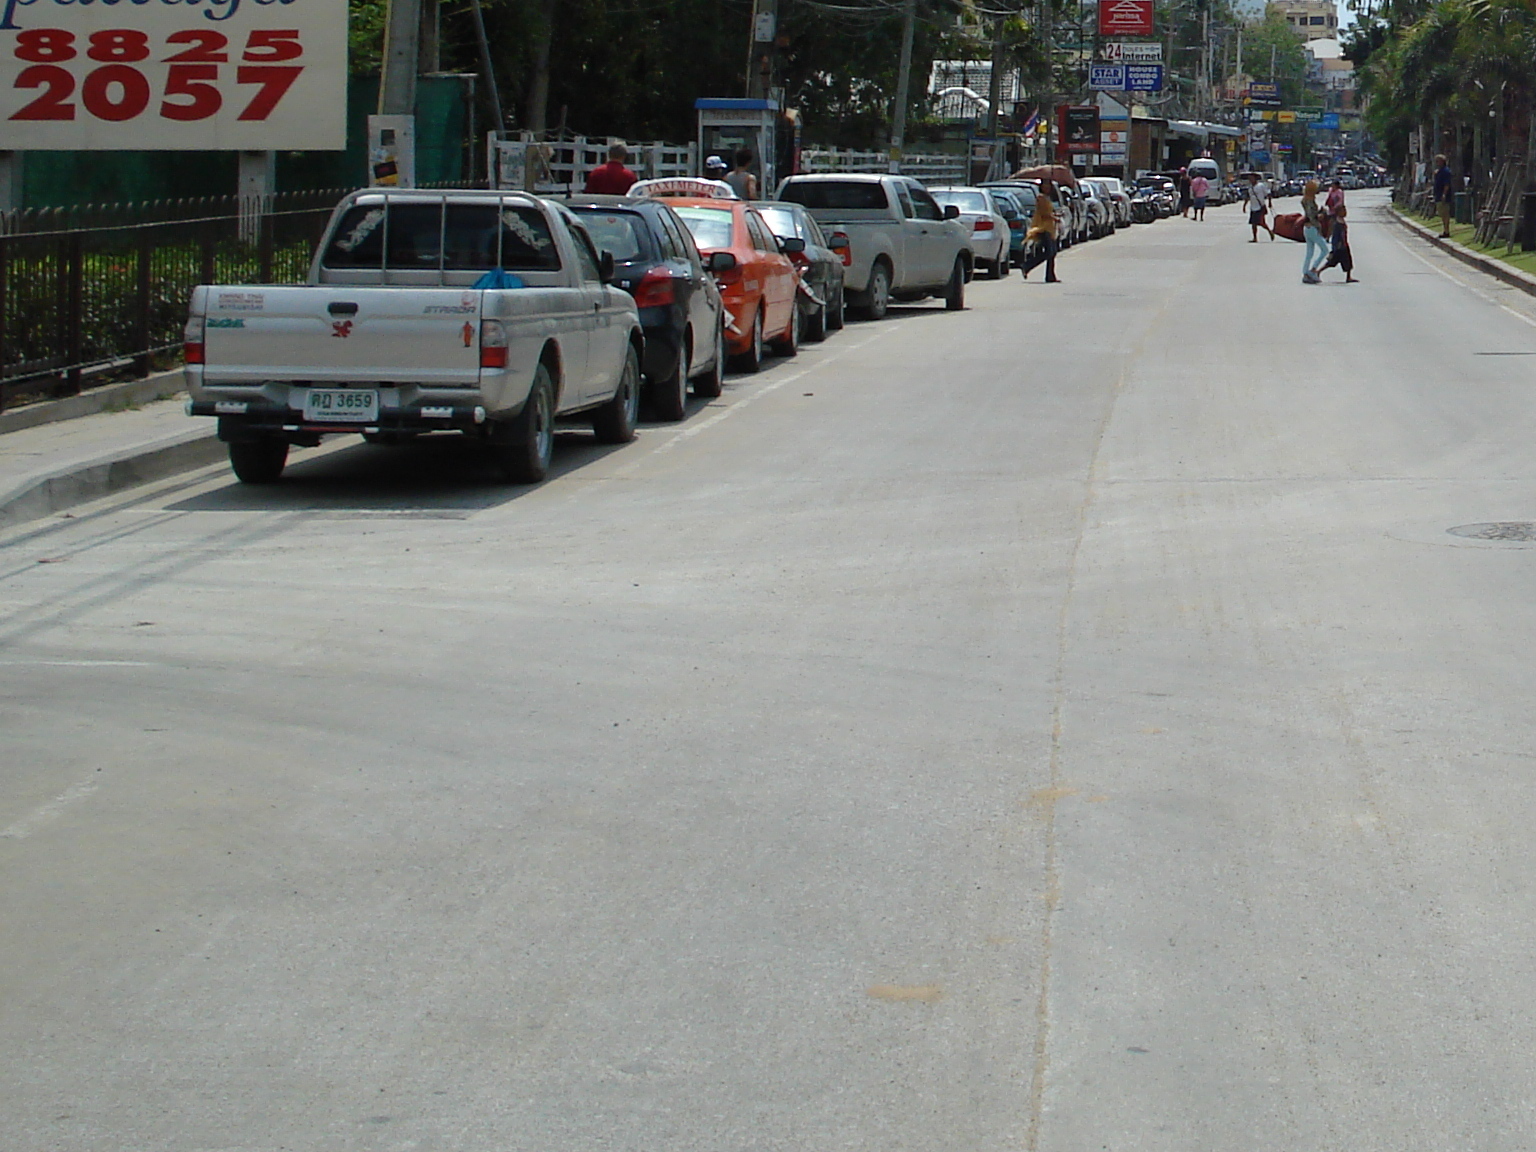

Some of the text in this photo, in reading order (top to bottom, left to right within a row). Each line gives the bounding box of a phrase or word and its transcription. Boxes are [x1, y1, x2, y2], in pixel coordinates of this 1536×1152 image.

[13, 28, 304, 64] 8825
[1107, 44, 1121, 59] 24
[1122, 52, 1160, 60] Internet
[1094, 69, 1120, 78] STAR
[7, 63, 306, 122] 2057
[336, 393, 372, 408] 3659
